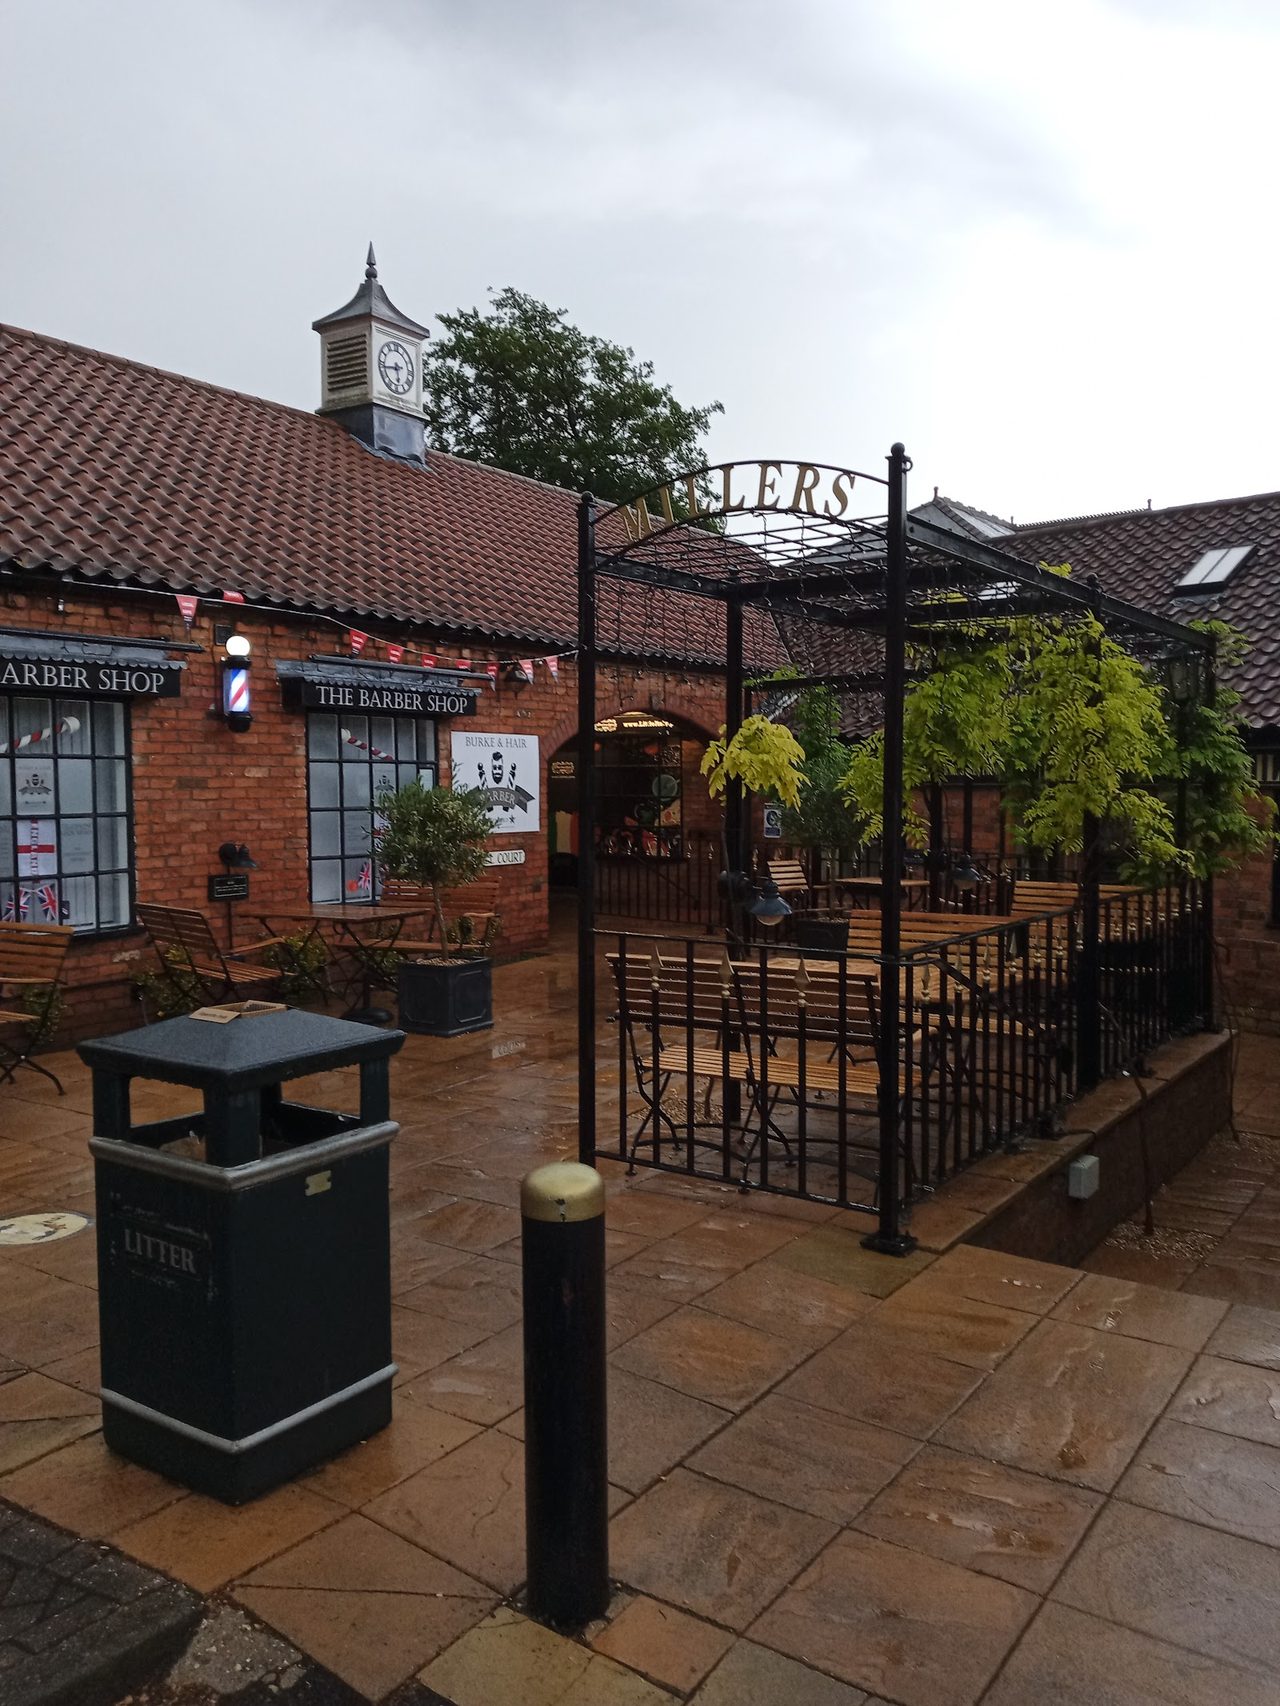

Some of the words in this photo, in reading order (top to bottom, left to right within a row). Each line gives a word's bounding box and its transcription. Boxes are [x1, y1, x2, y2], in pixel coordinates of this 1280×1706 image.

[620, 463, 856, 542] MILLERS
[98, 669, 165, 694] SHOP
[315, 685, 354, 706] THE
[358, 688, 424, 711] BARBER
[427, 694, 468, 714] SHOP
[465, 736, 495, 748] BURKE
[497, 737, 504, 748] &
[505, 738, 527, 748] HAIR
[496, 851, 524, 864] COURT
[124, 1228, 197, 1275] LITTER
